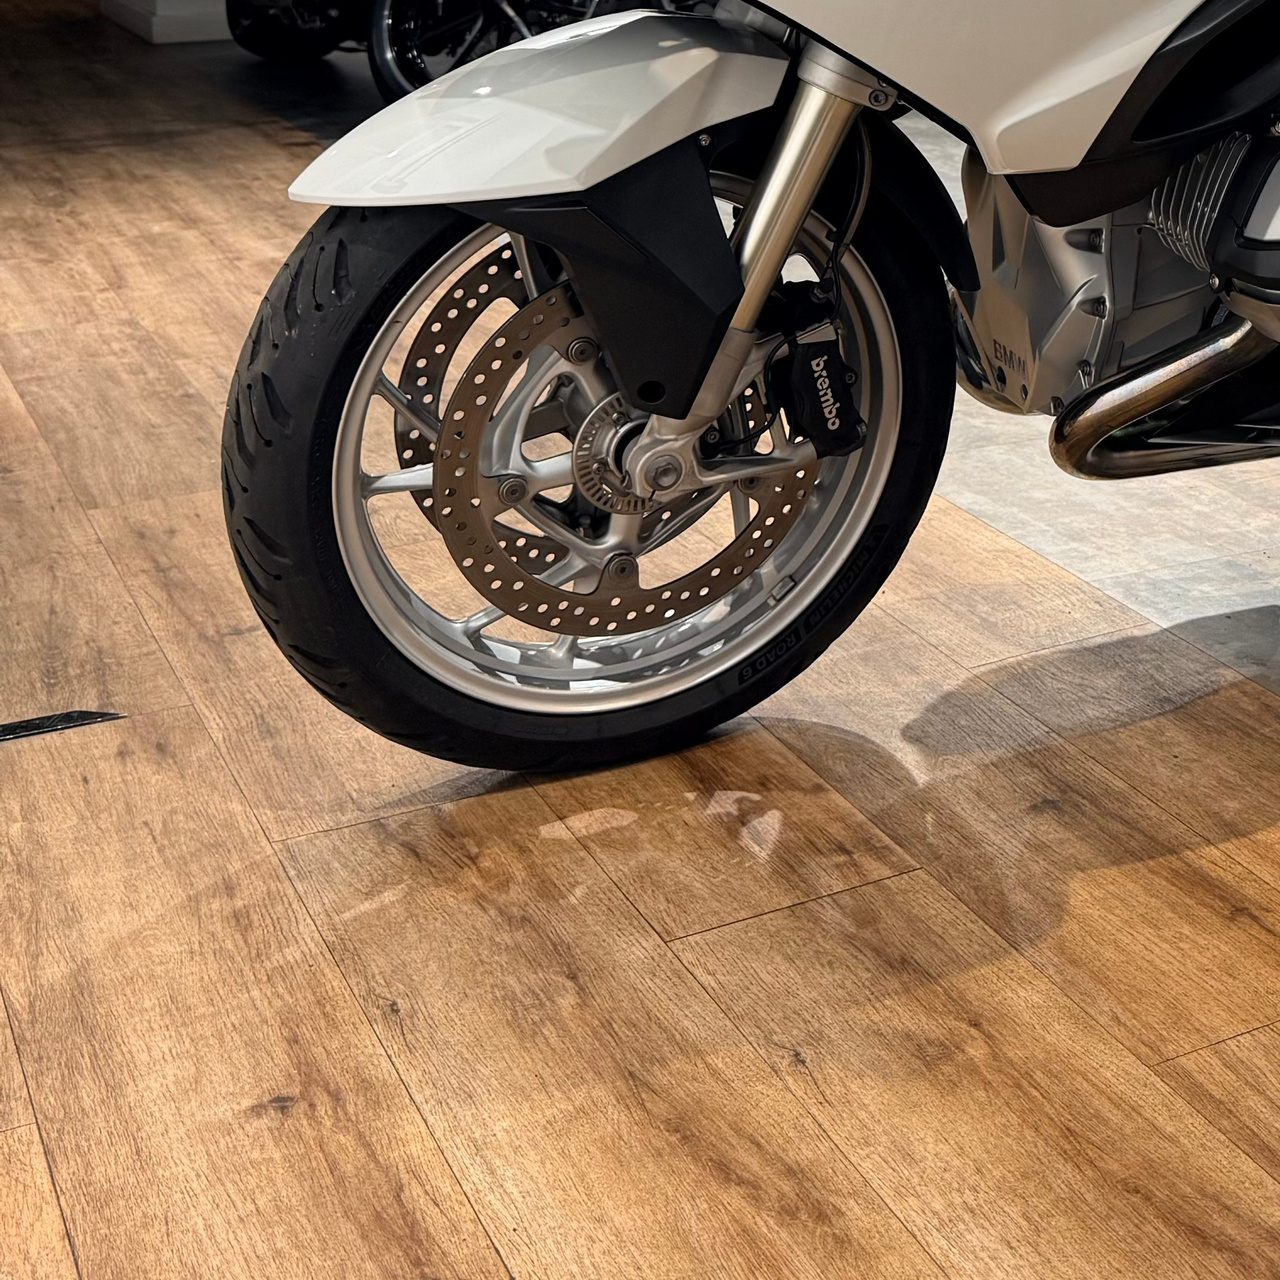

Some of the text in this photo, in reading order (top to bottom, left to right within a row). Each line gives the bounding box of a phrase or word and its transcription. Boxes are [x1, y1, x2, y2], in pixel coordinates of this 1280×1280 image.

[993, 339, 1026, 375] BMW
[810, 355, 840, 431] brembo
[756, 632, 797, 668] ROAD
